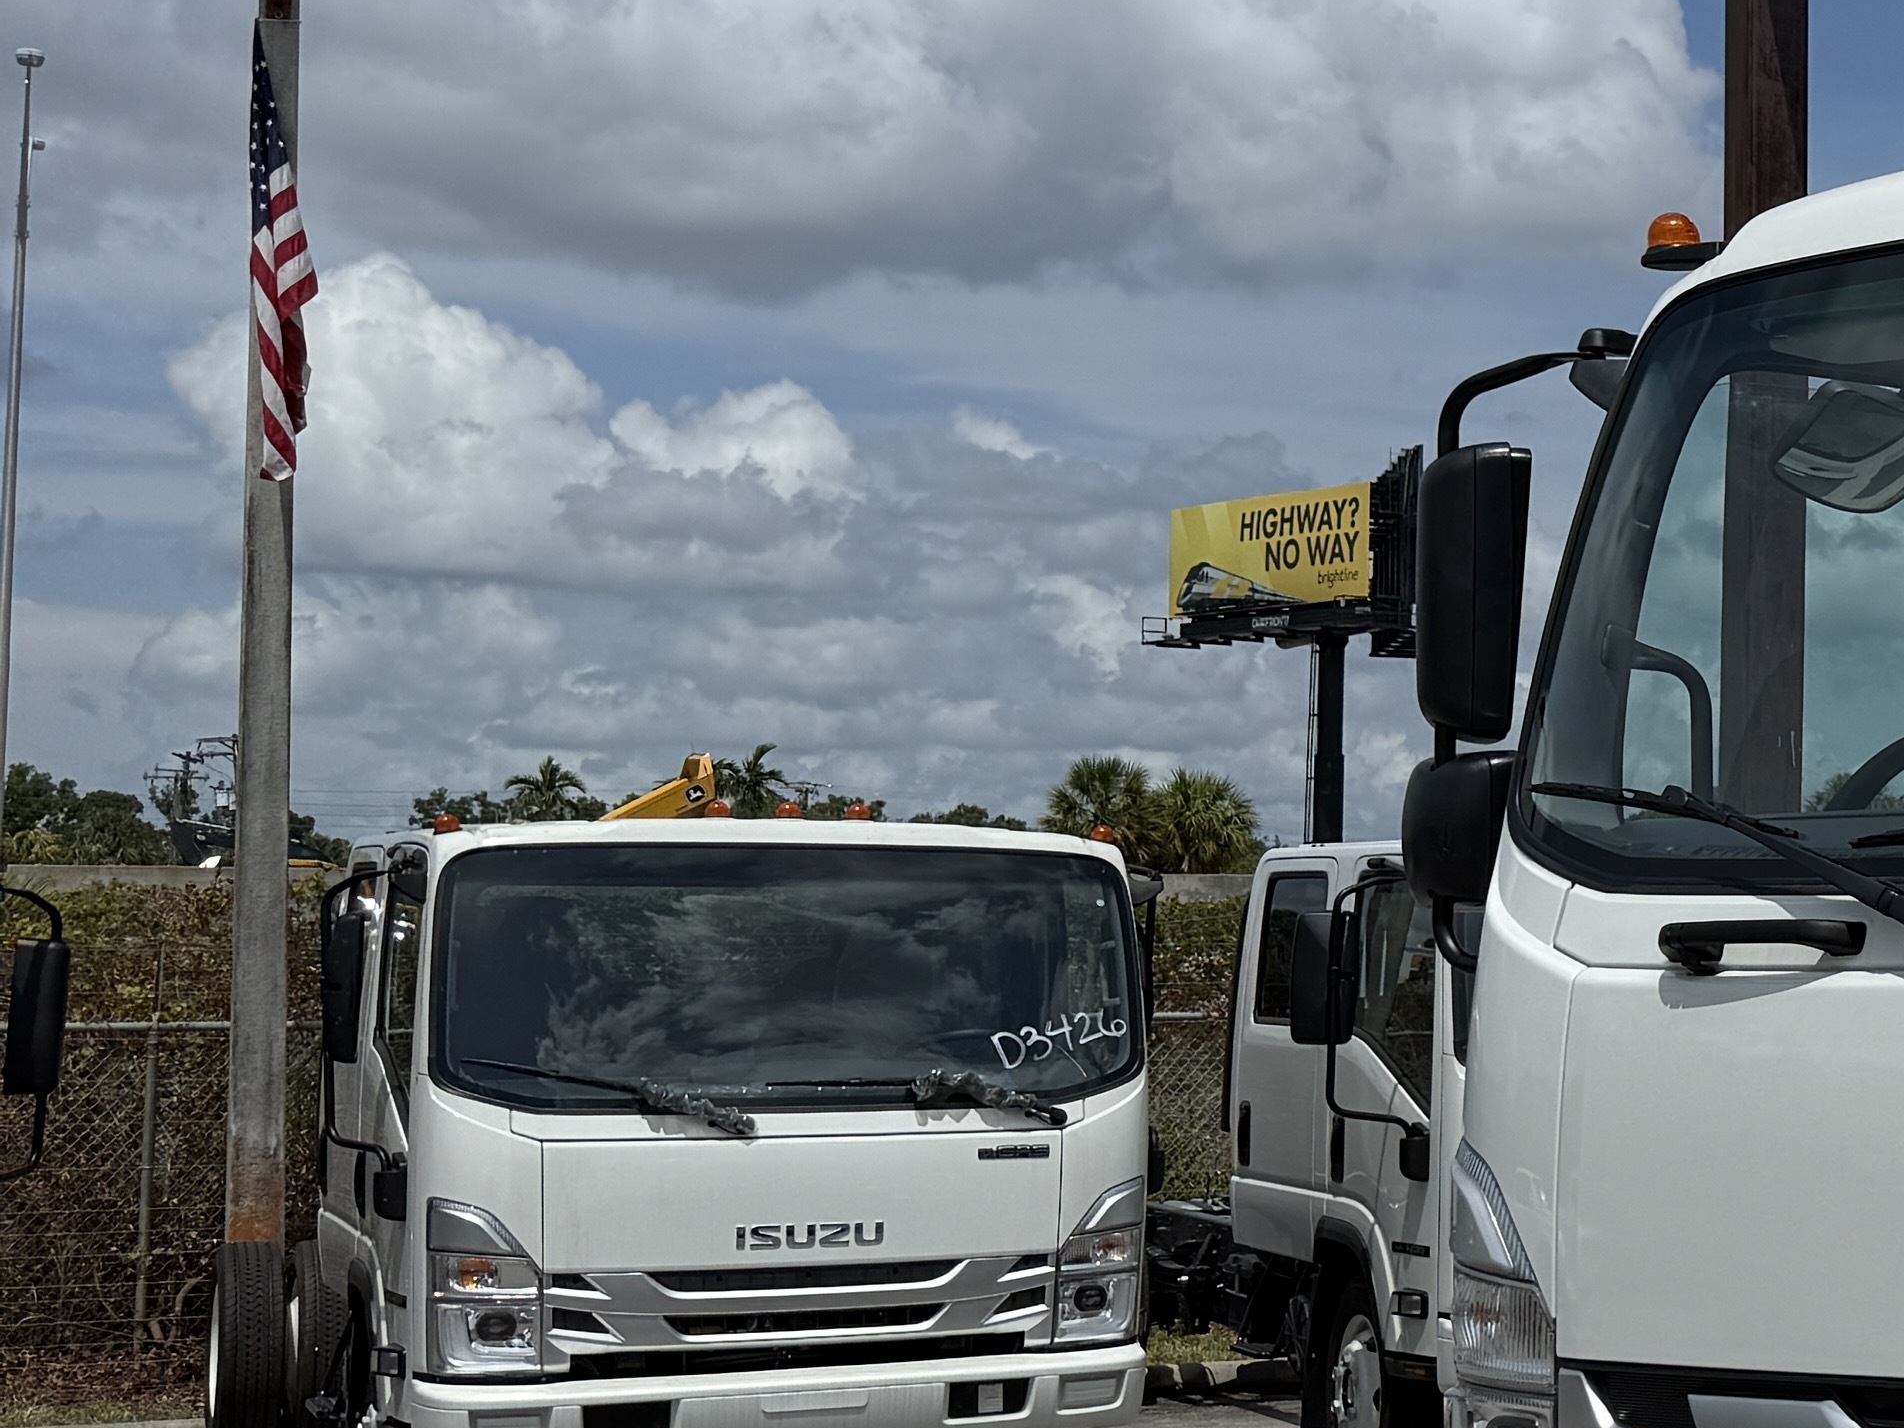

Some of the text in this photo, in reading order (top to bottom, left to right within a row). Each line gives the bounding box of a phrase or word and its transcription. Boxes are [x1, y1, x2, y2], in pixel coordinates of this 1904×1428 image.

[1240, 496, 1360, 542] HIGHWAY?
[1265, 530, 1360, 572] NO WAY
[1317, 567, 1359, 589] brightline
[990, 1008, 1127, 1069] D3426
[735, 1221, 884, 1251] ISUZU
